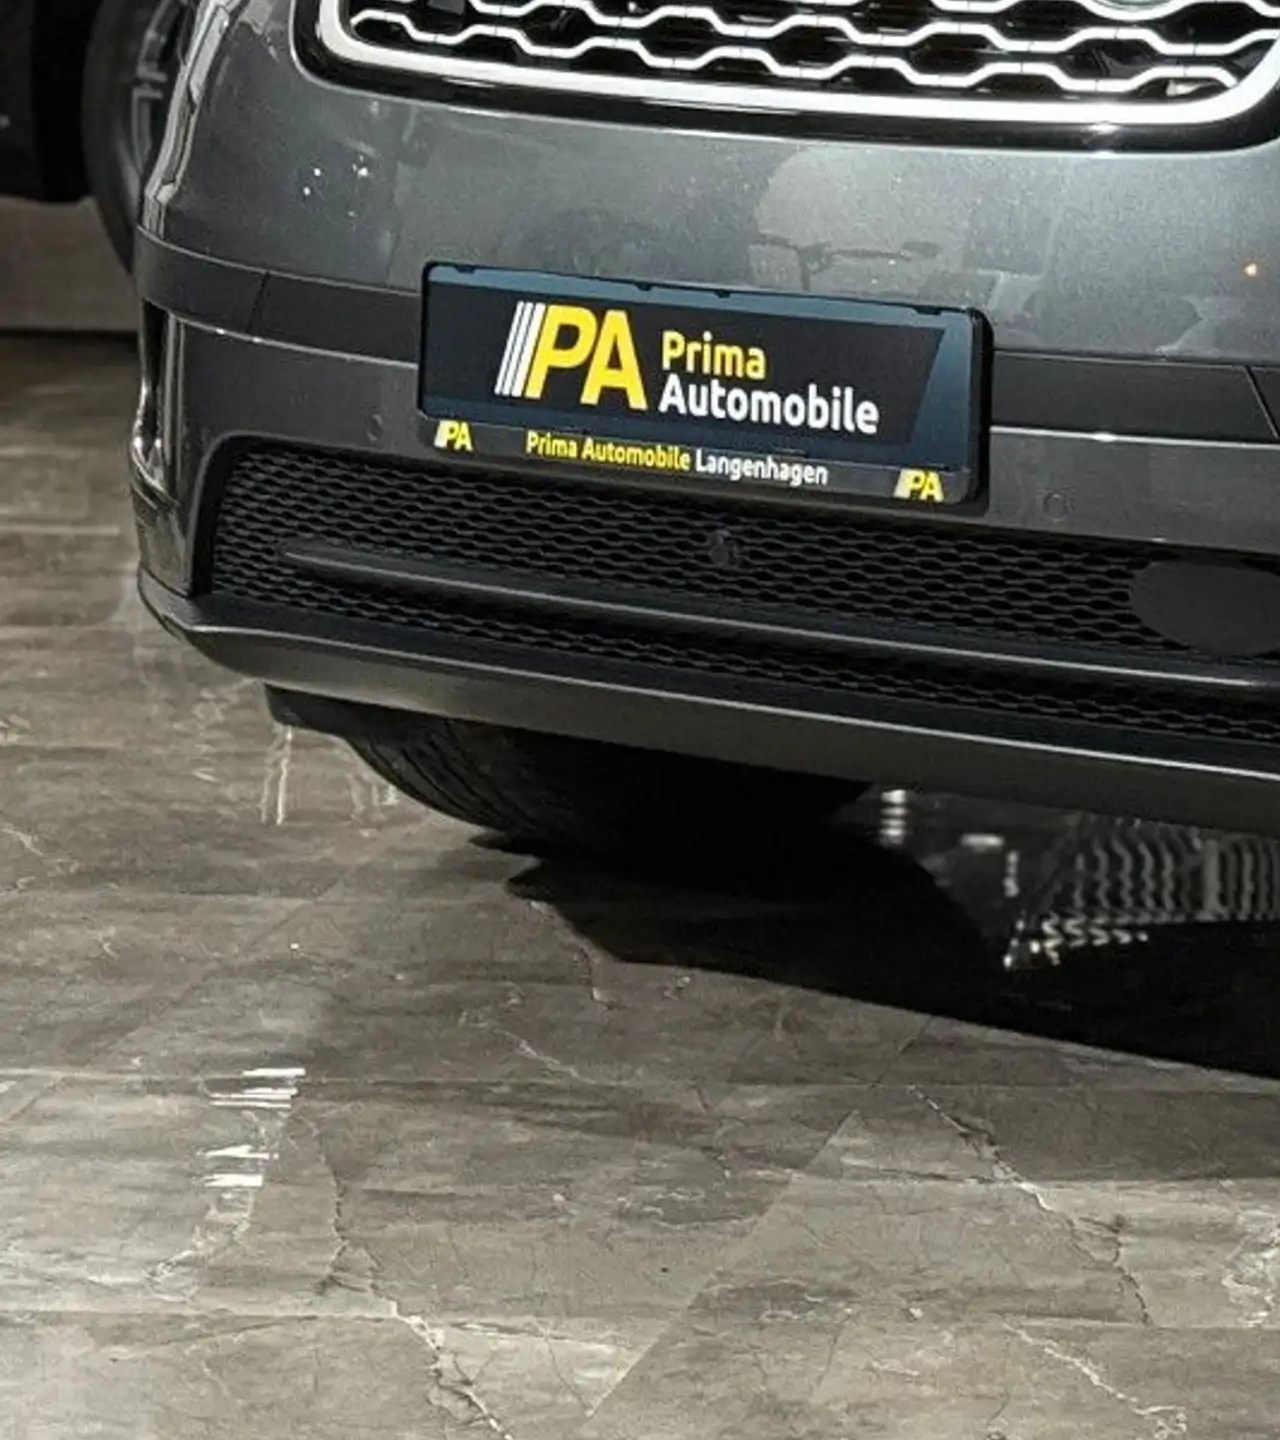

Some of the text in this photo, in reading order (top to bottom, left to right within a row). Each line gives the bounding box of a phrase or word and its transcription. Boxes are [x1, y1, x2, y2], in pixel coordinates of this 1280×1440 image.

[525, 304, 648, 410] PA
[661, 329, 766, 380] Prima
[657, 372, 880, 435] Automobile
[443, 420, 474, 452] PA
[526, 430, 829, 488] Prima Automobile Langenhagen
[905, 468, 945, 502] PA
